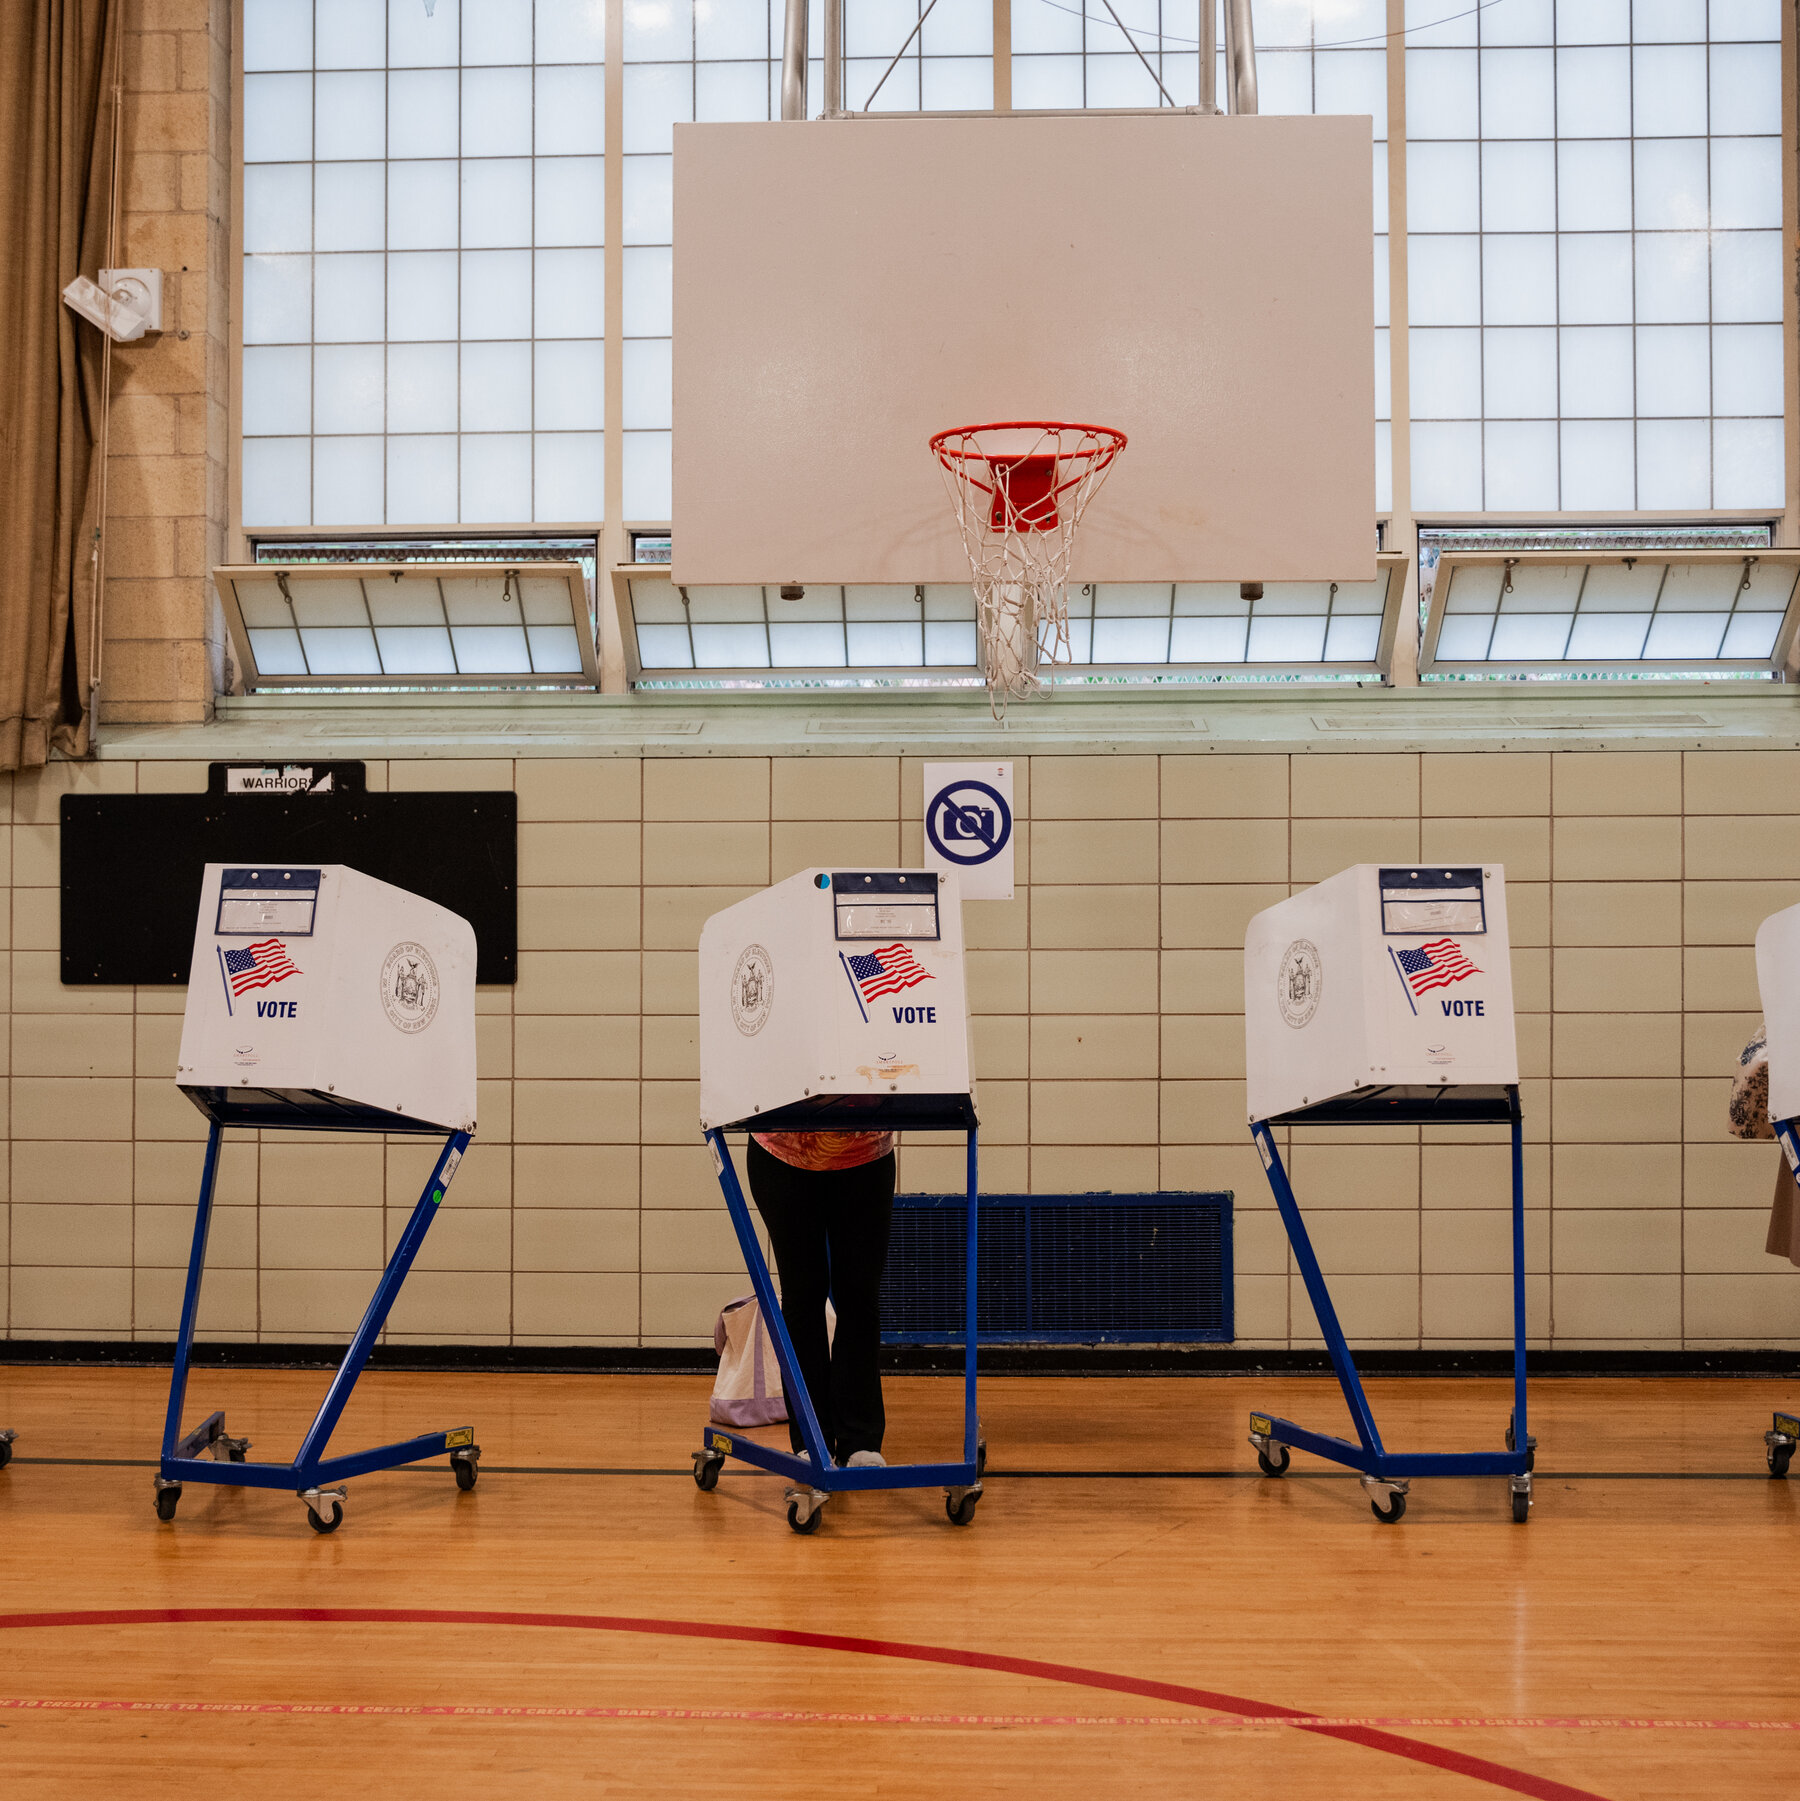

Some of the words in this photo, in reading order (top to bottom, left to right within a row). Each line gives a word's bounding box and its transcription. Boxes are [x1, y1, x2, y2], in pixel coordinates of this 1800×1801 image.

[257, 1001, 297, 1018] VOTE
[892, 1006, 937, 1024] VOTE
[1440, 1000, 1485, 1016] VOTE
